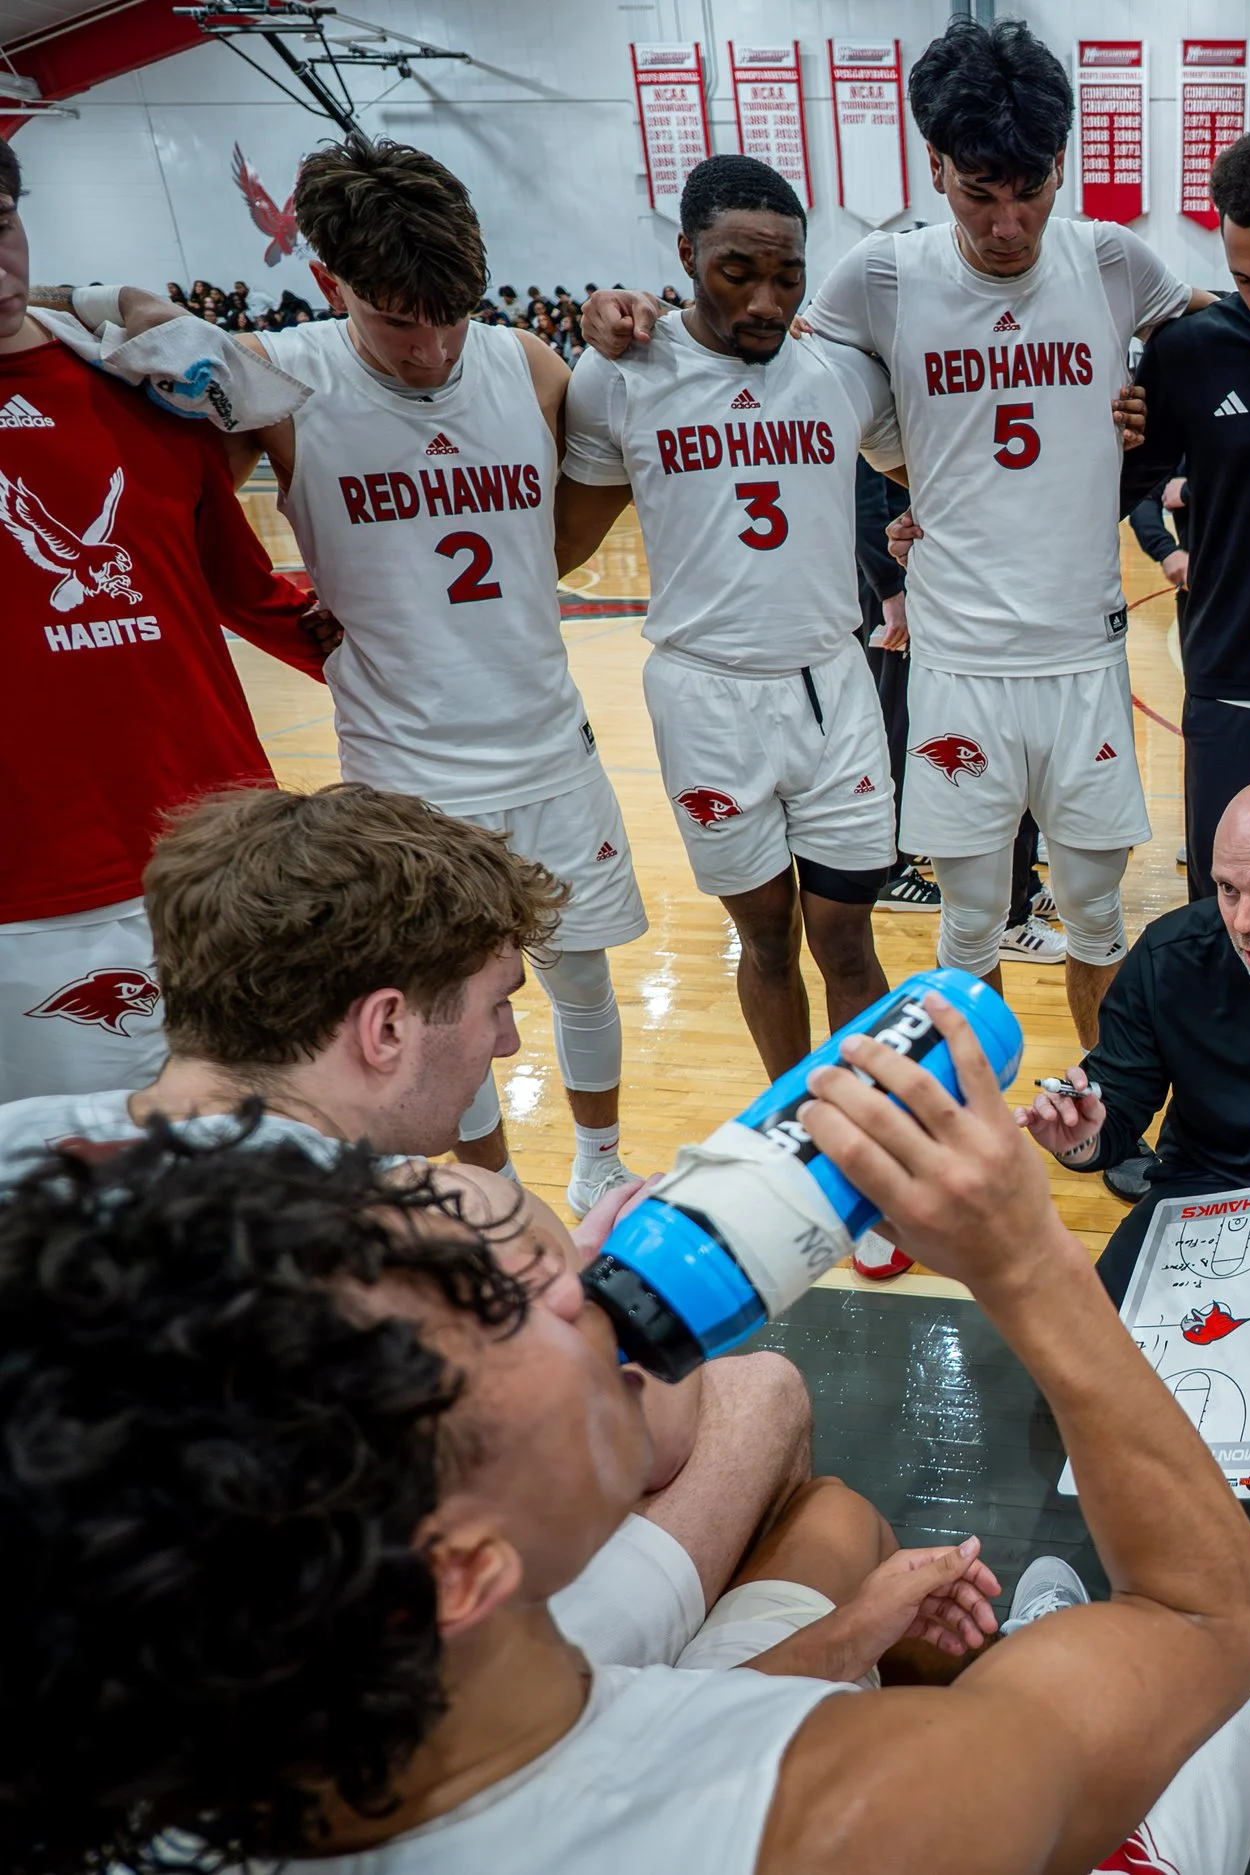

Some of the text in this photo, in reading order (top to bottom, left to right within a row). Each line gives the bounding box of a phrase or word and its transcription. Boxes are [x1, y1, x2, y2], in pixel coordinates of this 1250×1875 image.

[653, 88, 688, 102] NCAA
[751, 86, 786, 100] NCAA
[849, 85, 885, 99] NCAA
[1082, 87, 1141, 99] CONFERENCE
[1184, 87, 1243, 99] CONFERENCE
[1082, 100, 1141, 113] CHAMPIONS
[1184, 100, 1243, 113] CHAMPIONS
[993, 323, 1021, 332] adidas
[924, 342, 1093, 396] RED HAWKS
[730, 402, 761, 410] adidas
[993, 402, 1041, 470] 5
[425, 446, 460, 456] adidas
[656, 420, 836, 475] RED HAWKS
[338, 464, 542, 525] RED HAWKS
[734, 480, 789, 551] 3
[434, 531, 503, 605] 2
[44, 616, 162, 652] HABITS
